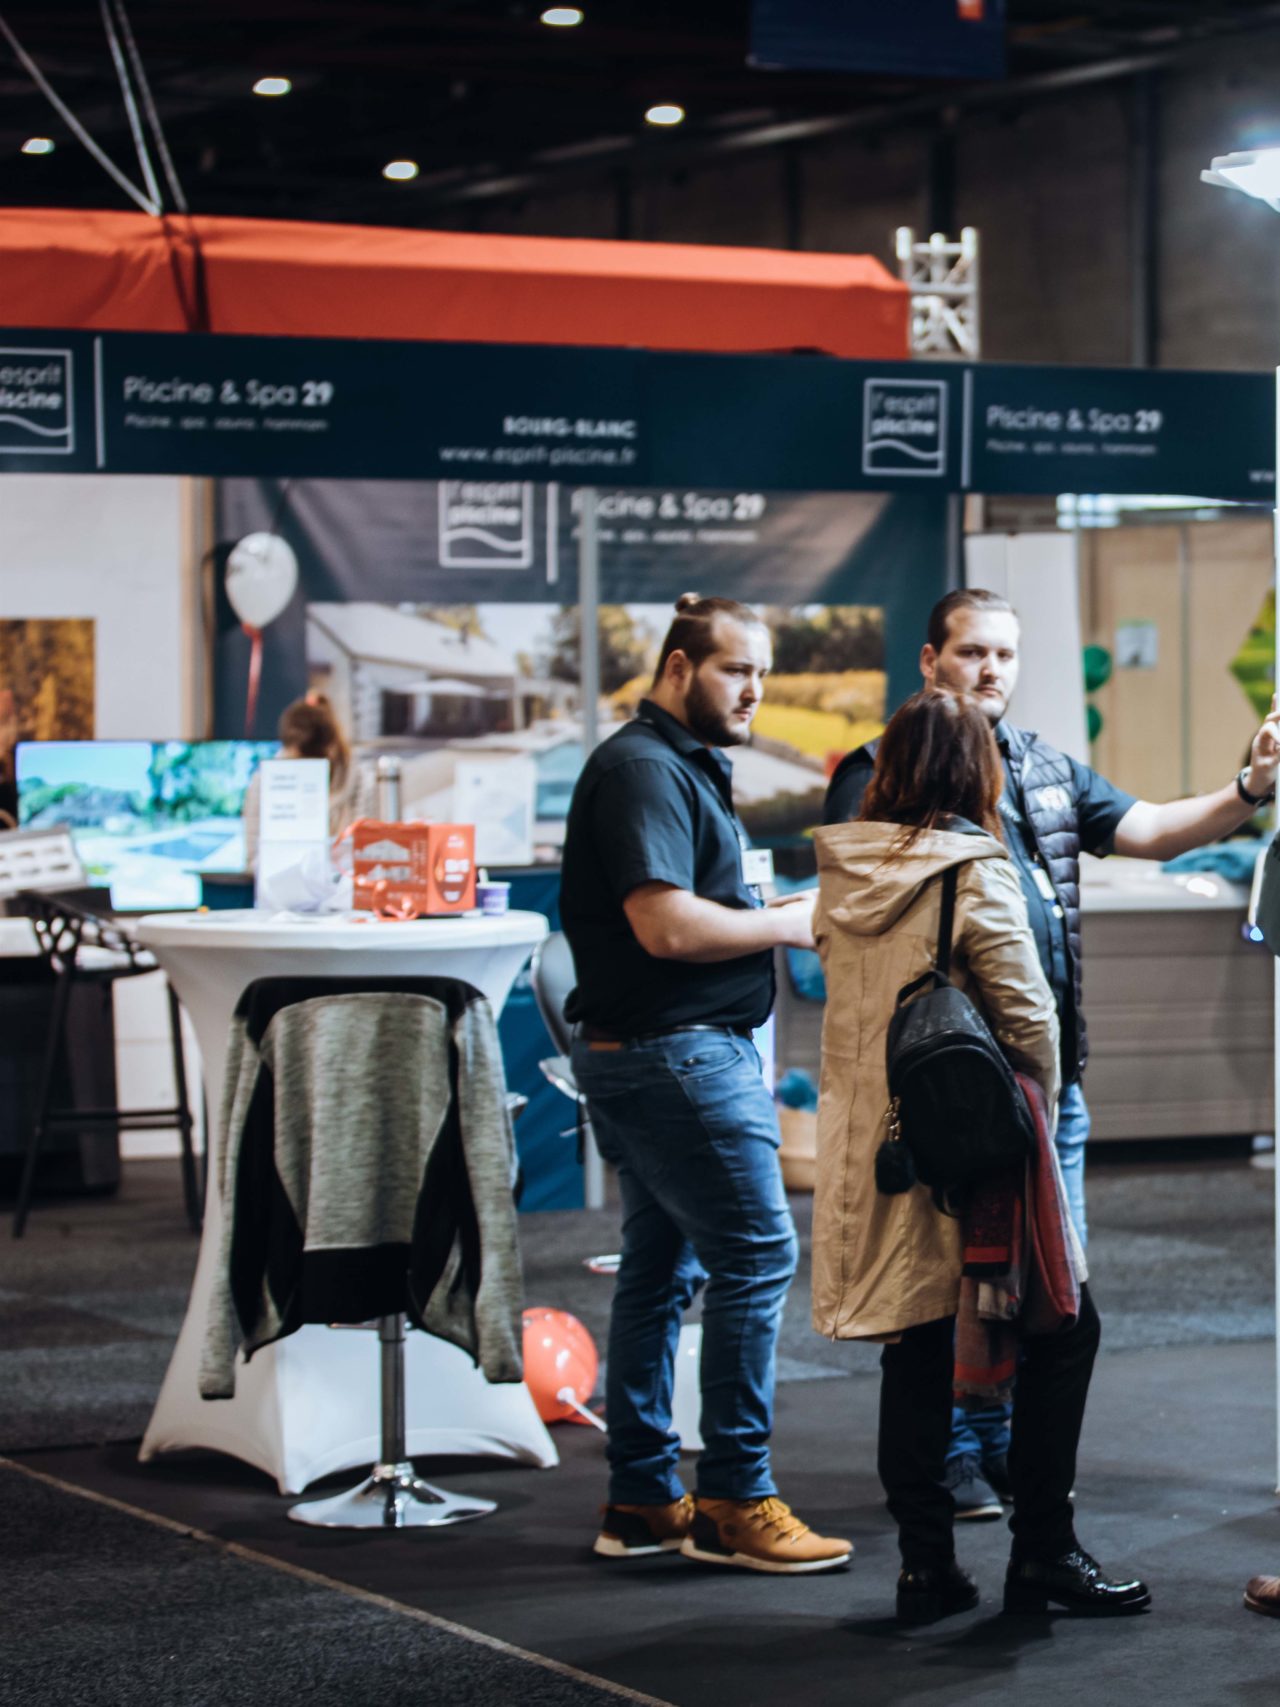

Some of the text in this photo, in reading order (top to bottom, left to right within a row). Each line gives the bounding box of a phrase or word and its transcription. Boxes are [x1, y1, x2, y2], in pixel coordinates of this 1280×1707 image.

[124, 376, 334, 409] Piscine & Spa 29
[987, 405, 1061, 431] Piscine
[1089, 407, 1131, 435] Spa
[1134, 410, 1162, 432] 29
